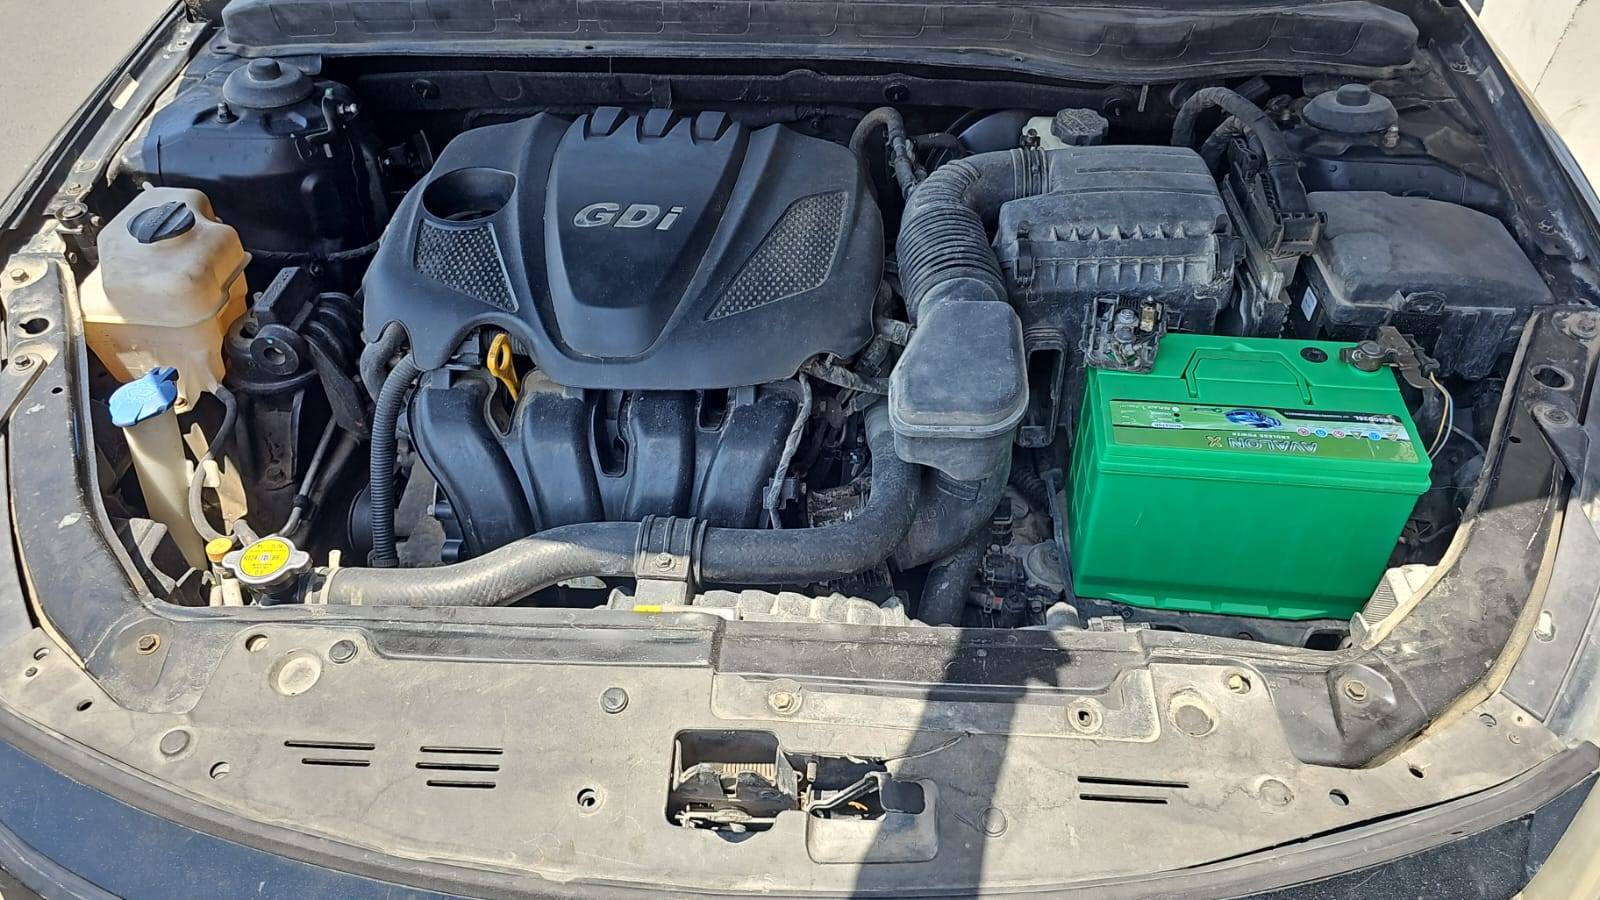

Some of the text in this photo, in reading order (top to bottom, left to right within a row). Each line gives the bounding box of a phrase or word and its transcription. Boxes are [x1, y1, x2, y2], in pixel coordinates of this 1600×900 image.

[573, 202, 684, 230] GDi
[1205, 436, 1318, 453] AVALON X
